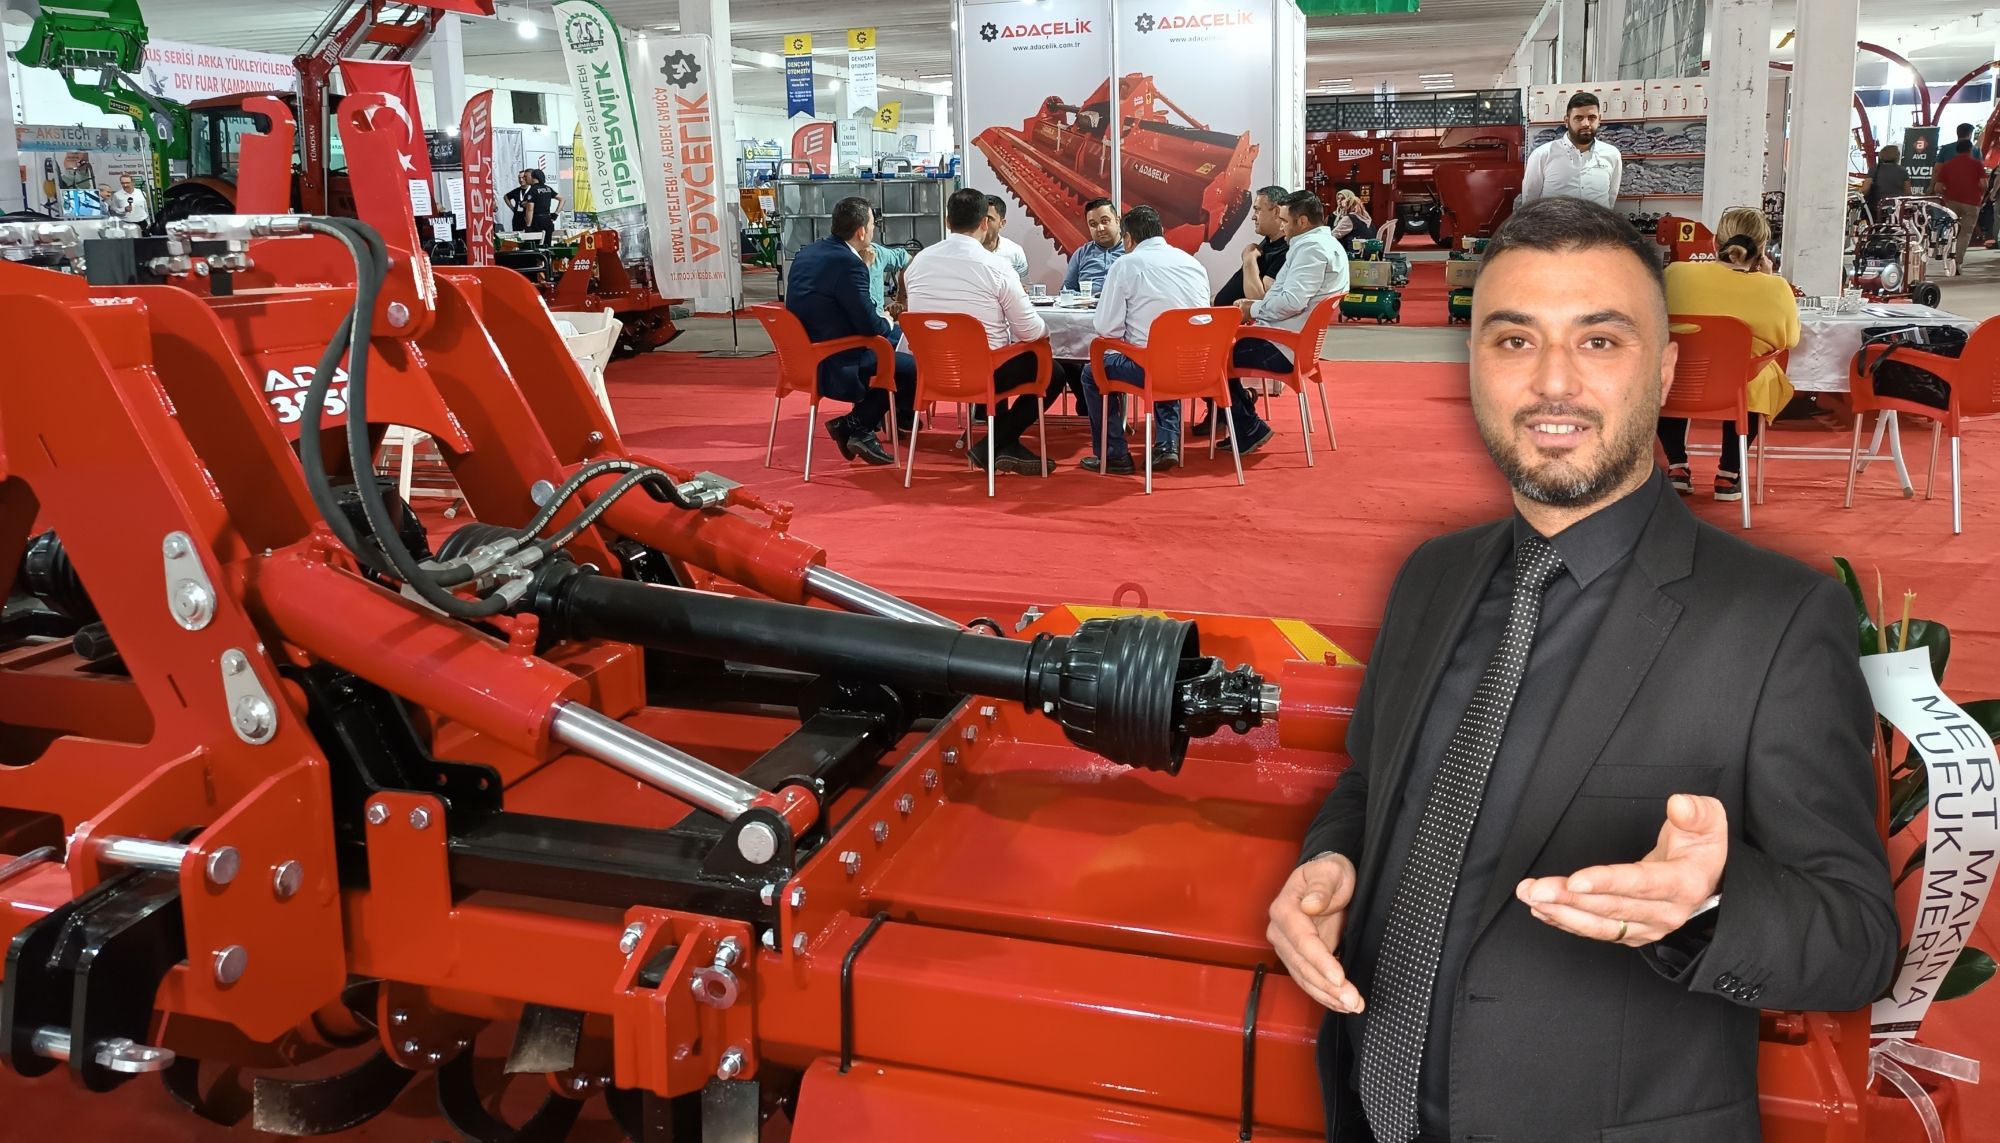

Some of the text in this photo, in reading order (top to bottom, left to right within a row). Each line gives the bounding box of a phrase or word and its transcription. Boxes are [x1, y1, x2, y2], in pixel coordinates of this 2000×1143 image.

[1000, 18, 1092, 39] ADAÇELİK
[1157, 9, 1254, 30] ADAÇELİK
[165, 48, 195, 66] SERİSİ
[198, 54, 224, 69] ARKA
[174, 73, 275, 94] DEV FUAR KAMPANYASI
[36, 127, 90, 140] AKSTECH
[1338, 148, 1373, 156] BURKON
[1916, 731, 1963, 854] UFUK
[1898, 695, 1998, 1009] MERT MAKİNA
[1903, 870, 1958, 970] MERT
